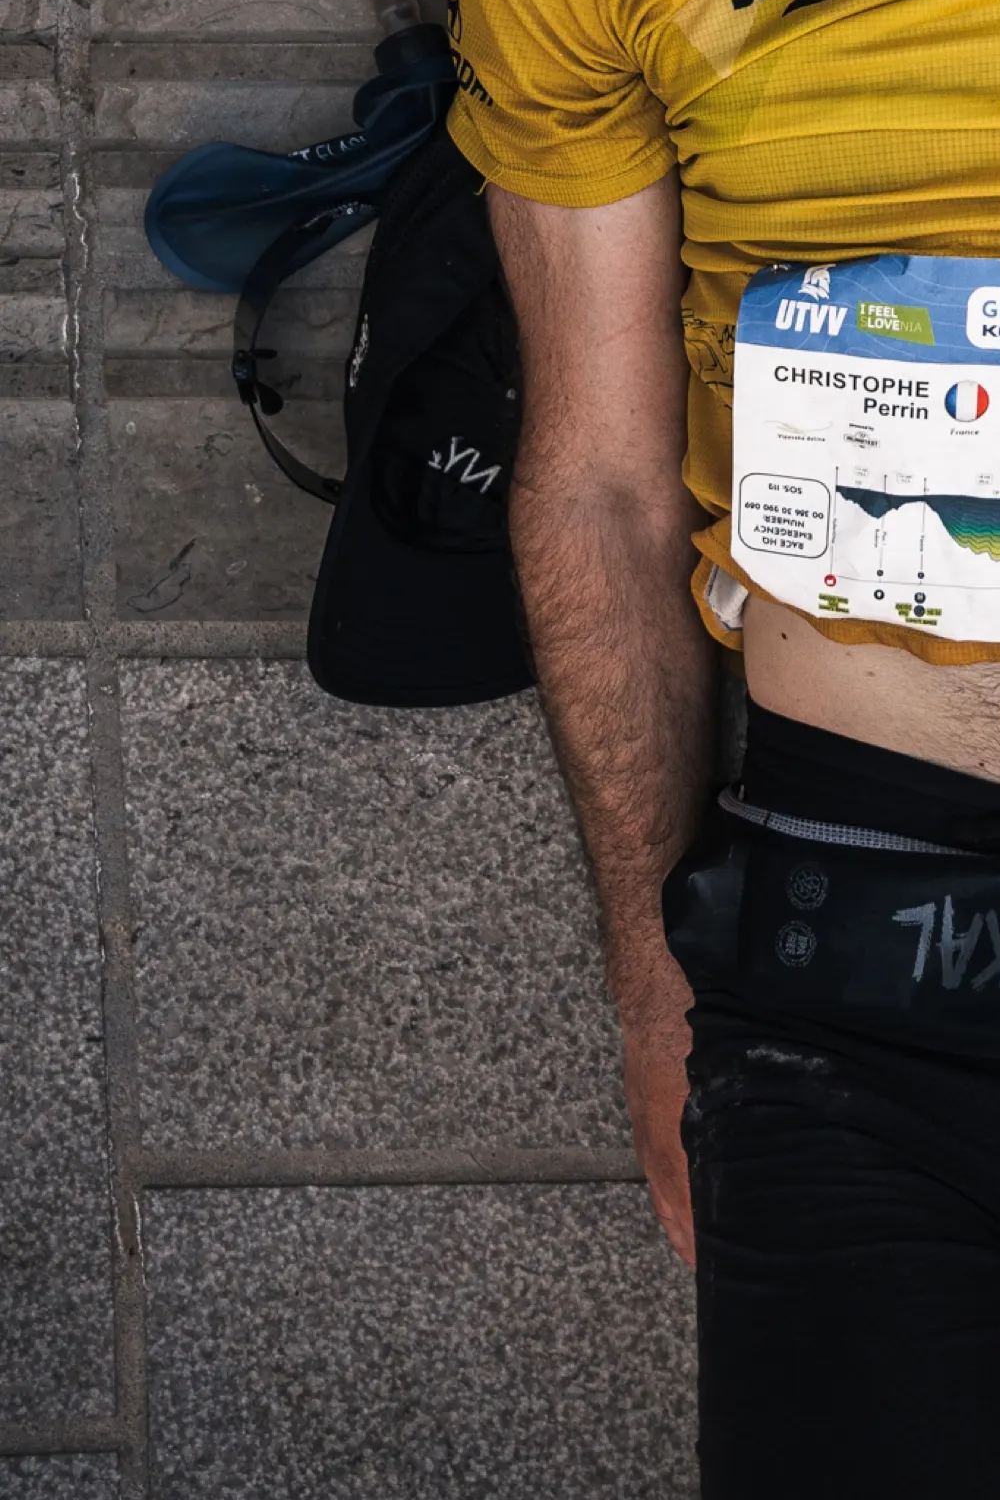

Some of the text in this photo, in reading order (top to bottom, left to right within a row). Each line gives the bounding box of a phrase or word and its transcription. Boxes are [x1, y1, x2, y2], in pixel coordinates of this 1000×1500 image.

[775, 298, 849, 337] UTVV
[859, 303, 899, 318] I FEEL
[859, 316, 923, 333] SLOVENIA
[773, 365, 930, 399] CHRISTOPHE
[863, 397, 930, 421] Perrin
[753, 525, 814, 541] EMERGENCY
[762, 536, 804, 550] RACE HQ
